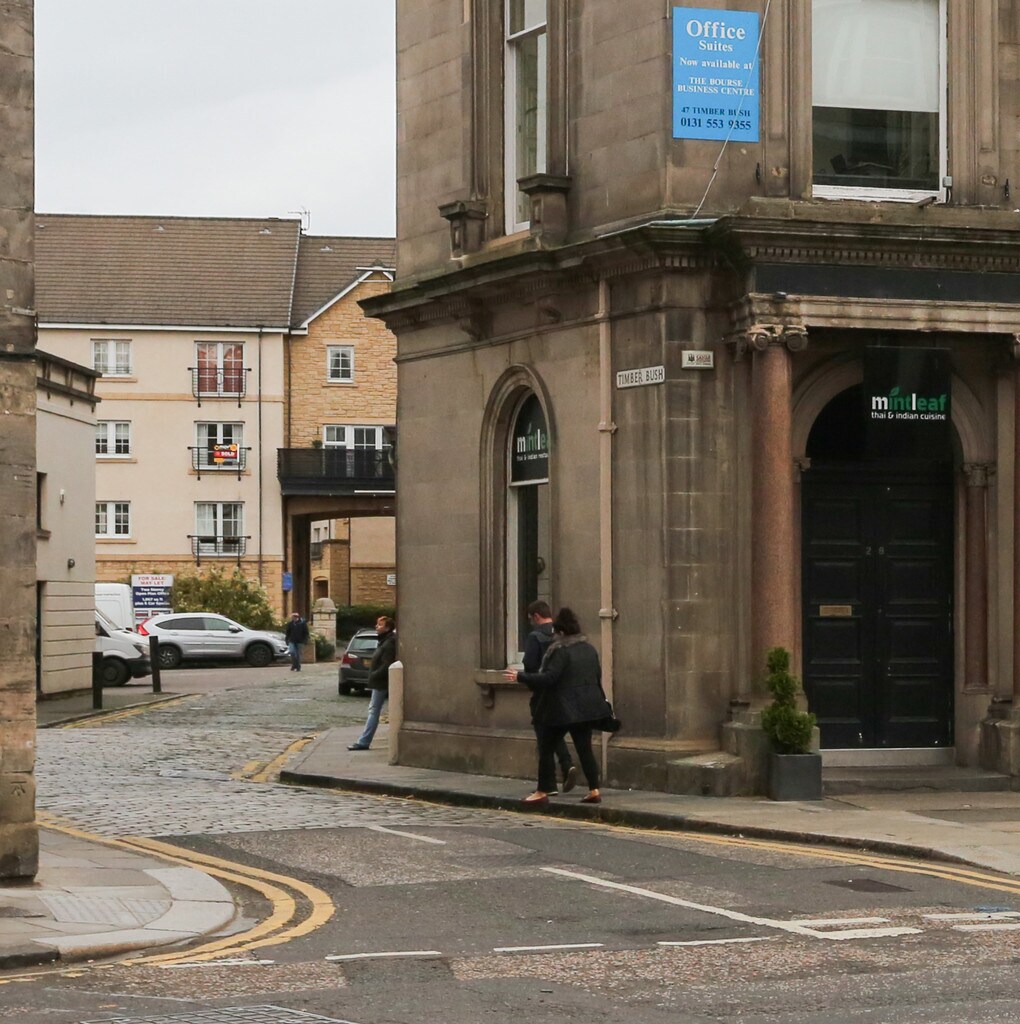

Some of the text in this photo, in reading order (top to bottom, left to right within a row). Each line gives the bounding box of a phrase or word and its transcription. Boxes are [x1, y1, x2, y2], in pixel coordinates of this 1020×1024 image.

[686, 19, 746, 40] Office
[699, 39, 733, 52] Suites
[680, 56, 752, 70] Now available at
[689, 76, 743, 87] THE BOURSE
[677, 84, 755, 96] BUSINESS CENTRE
[692, 107, 725, 116] TIMBER
[680, 117, 752, 131] 0131 553 9355
[618, 368, 664, 385] TIMBER BUSH
[871, 388, 947, 411] mintleaf
[871, 411, 886, 419] thai
